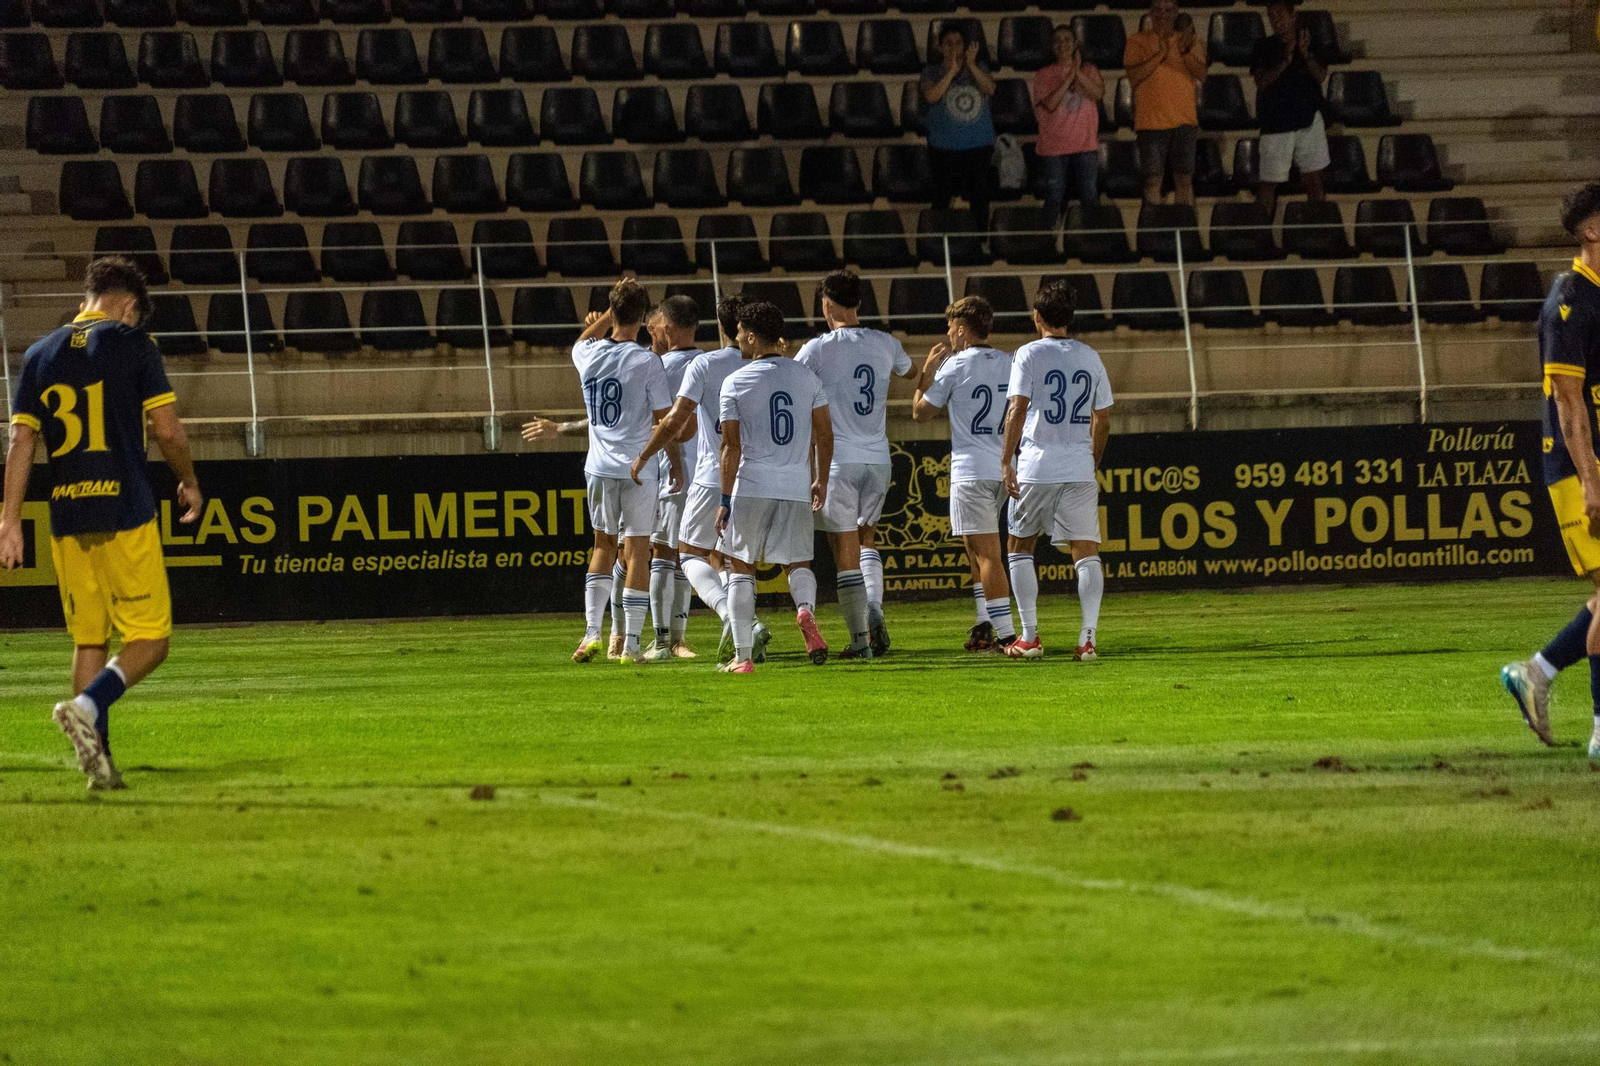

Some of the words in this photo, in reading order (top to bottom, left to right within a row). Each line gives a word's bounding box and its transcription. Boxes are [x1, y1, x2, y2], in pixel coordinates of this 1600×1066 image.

[584, 377, 622, 428] 18
[854, 364, 875, 416] 3
[1044, 369, 1092, 424] 32
[40, 381, 109, 457] 31
[770, 391, 794, 445] 6
[1427, 427, 1515, 453] Pollería
[1096, 465, 1200, 494] NTIC@S
[1234, 462, 1286, 489] 959
[1294, 460, 1344, 487] 481
[1355, 458, 1403, 485] 331
[1418, 462, 1448, 488] LA
[1454, 459, 1532, 487] PLAZA
[160, 496, 277, 546] LAS
[298, 489, 588, 543] PALMERIT
[1056, 501, 1239, 552] LLOS
[1255, 498, 1295, 546] Y
[1314, 490, 1534, 545] POLLAS
[239, 554, 266, 575] Tu
[274, 553, 345, 574] tienda
[352, 549, 488, 576] especialista
[495, 553, 523, 568] en
[884, 555, 898, 569] A
[904, 553, 970, 568] PLAZA
[1038, 564, 1114, 581] PORTL
[1118, 562, 1136, 578] AL
[1139, 556, 1198, 577] CARBÓN
[1203, 545, 1535, 577] www.polloasadolaantilla.com
[886, 579, 903, 591] LA
[904, 577, 957, 590] ANTILLA
